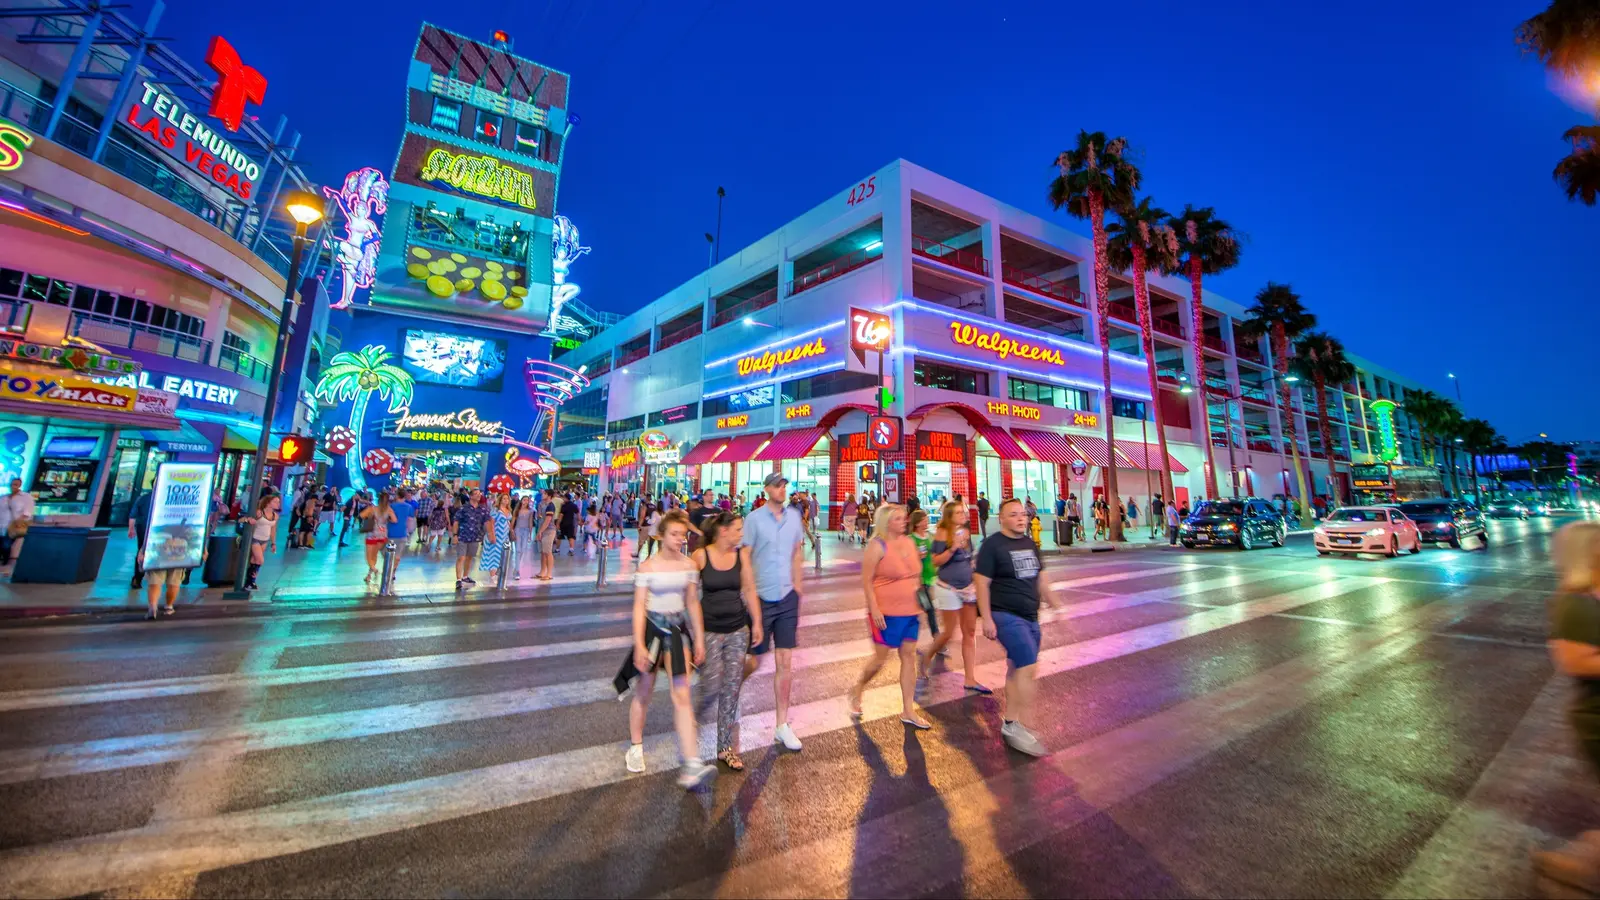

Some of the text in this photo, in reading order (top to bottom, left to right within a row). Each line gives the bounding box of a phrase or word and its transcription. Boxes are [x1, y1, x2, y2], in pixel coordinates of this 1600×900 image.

[143, 81, 260, 182] TELEMUNDO
[128, 104, 253, 199] LAS VEGAS
[847, 176, 876, 207] 425
[950, 320, 1065, 366] Walgreens
[737, 337, 826, 376] Walgreens
[49, 387, 126, 406] SHACK
[163, 375, 240, 405] EATERY
[786, 404, 812, 419] 24-HR
[987, 401, 1040, 420] 1-HR PHOTO
[1073, 412, 1097, 426] 24-HR
[395, 406, 502, 436] Fremont Street
[411, 431, 479, 443] EXPERIENCE
[850, 432, 867, 447] OPE
[930, 431, 953, 447] OPEN
[168, 442, 207, 452] TERIYAKI
[841, 447, 851, 462] 24
[920, 445, 963, 462] 24 HOURS
[166, 484, 201, 496] 100%
